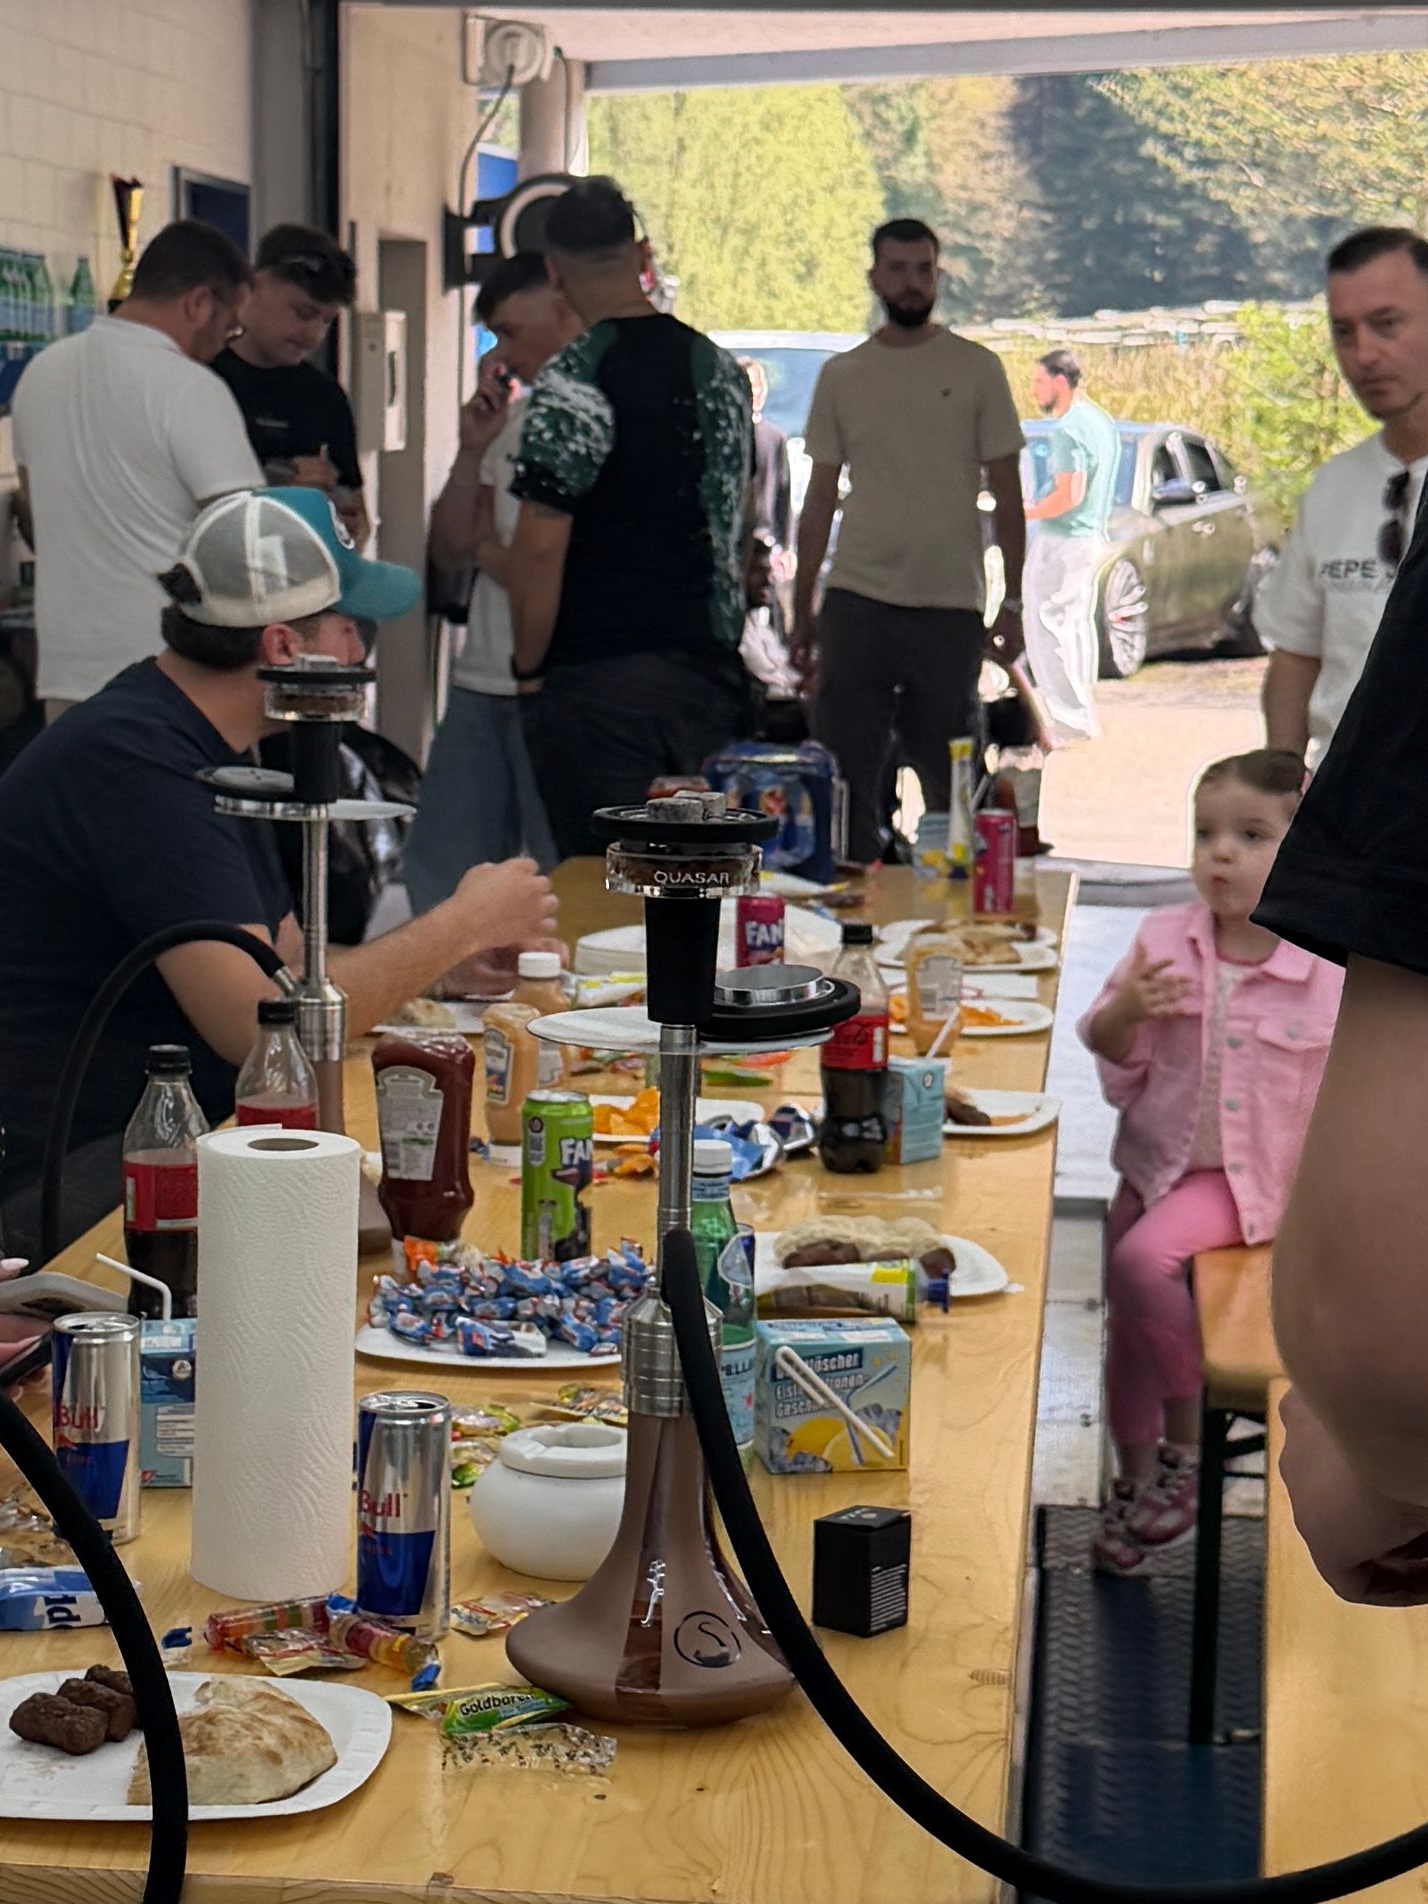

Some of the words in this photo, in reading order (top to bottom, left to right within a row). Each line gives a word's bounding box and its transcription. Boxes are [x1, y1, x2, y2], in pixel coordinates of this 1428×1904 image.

[654, 870, 730, 885] QUASAR
[54, 1406, 99, 1430] Bull
[358, 1489, 401, 1518] Bull
